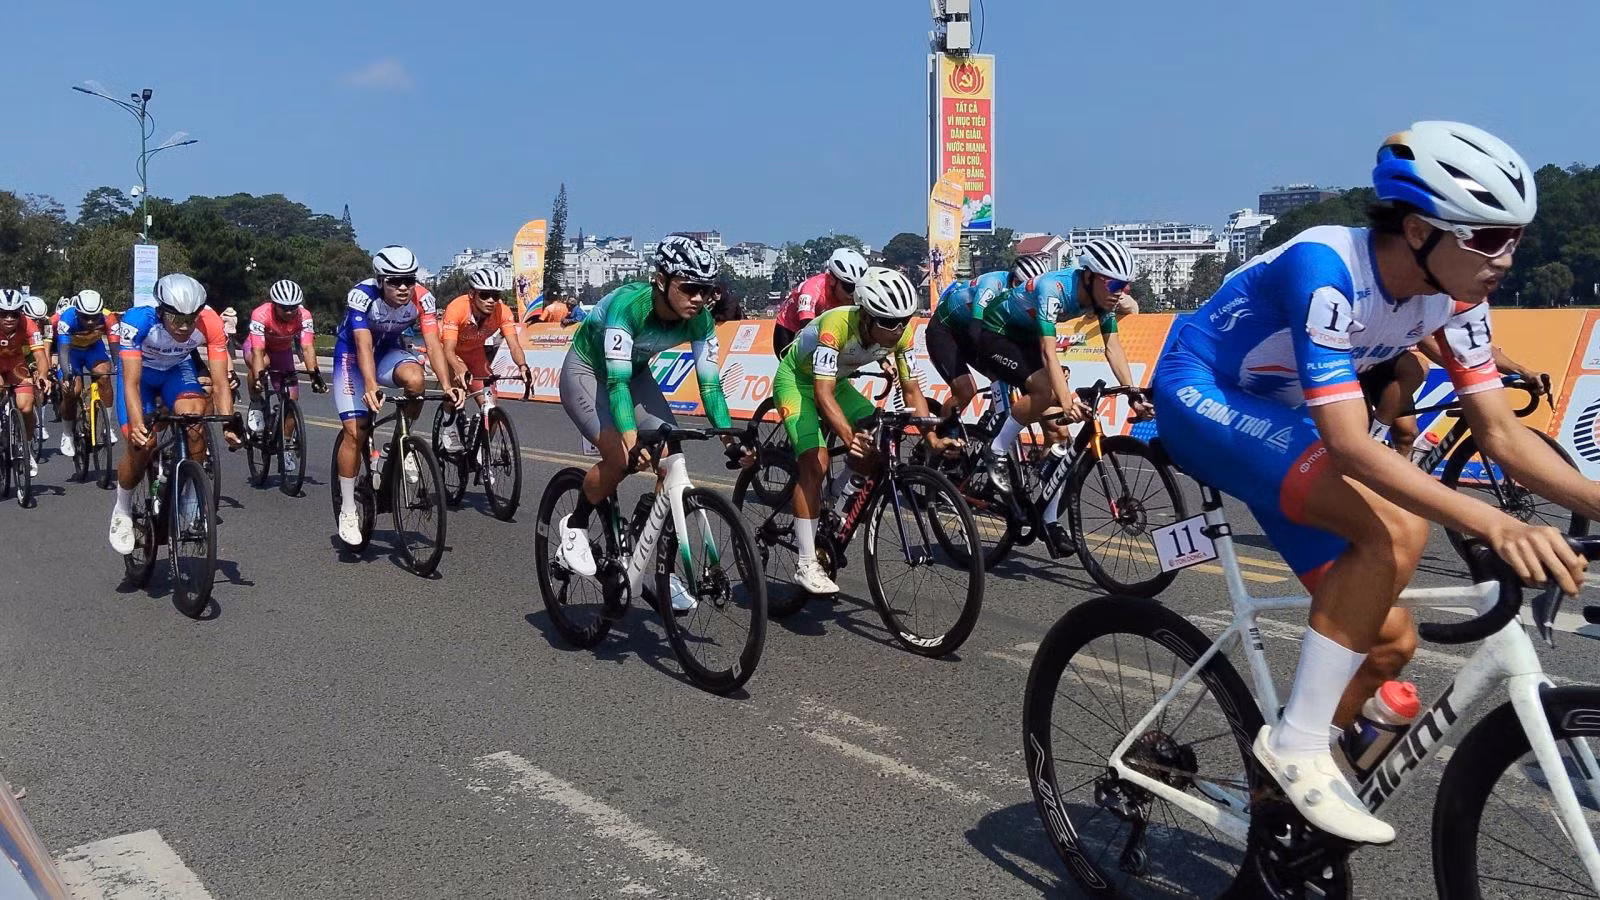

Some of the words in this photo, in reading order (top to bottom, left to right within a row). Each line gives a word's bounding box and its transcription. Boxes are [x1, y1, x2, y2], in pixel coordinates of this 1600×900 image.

[955, 100, 967, 113] TẤT
[951, 153, 965, 165] DÂN
[350, 291, 369, 306] 104
[612, 333, 623, 351] 2
[814, 350, 836, 371] 146
[1043, 440, 1078, 502] GIANT
[658, 522, 674, 575] BLAC
[1168, 524, 1199, 558] 11
[1357, 681, 1459, 815] GIANT
